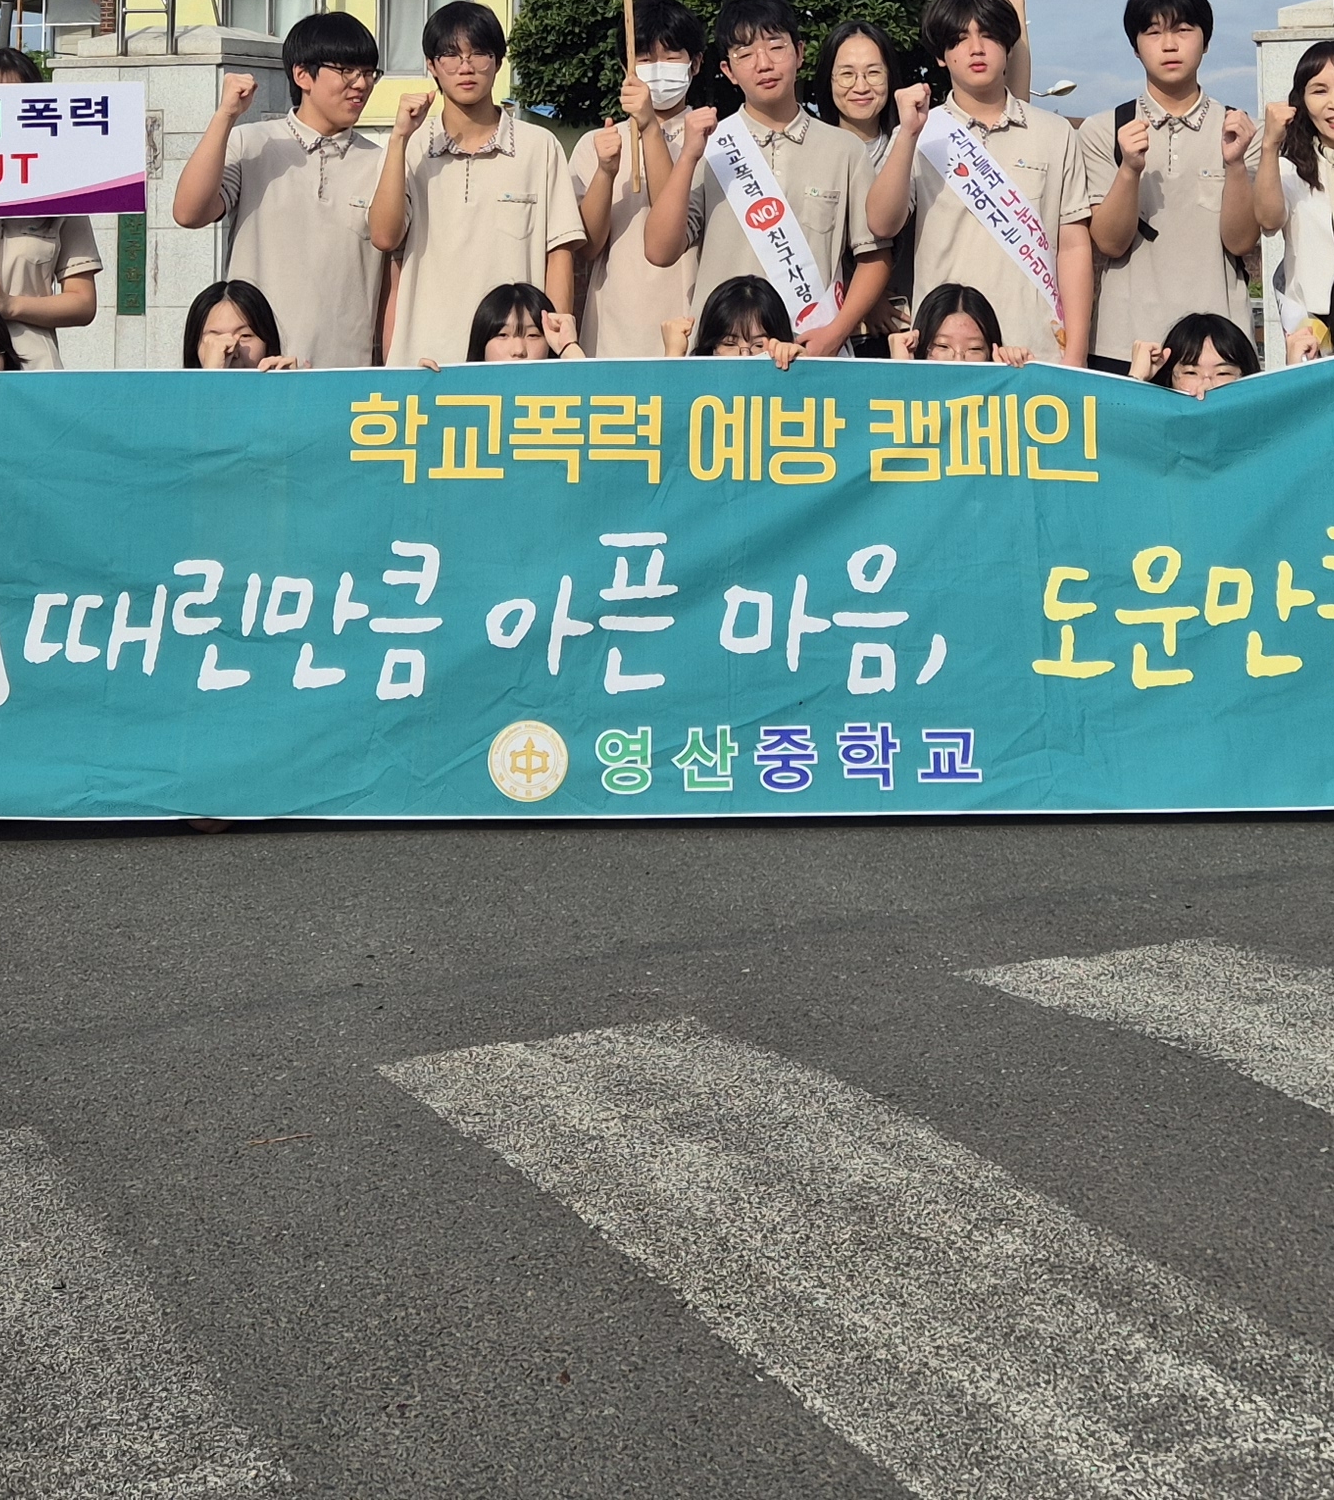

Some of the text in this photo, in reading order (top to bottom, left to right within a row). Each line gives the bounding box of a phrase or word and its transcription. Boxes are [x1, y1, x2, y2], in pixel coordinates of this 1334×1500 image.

[17, 96, 110, 137] 폭력
[716, 134, 764, 197] 학교폭력
[750, 200, 780, 226] NO!
[948, 128, 1005, 190] 친구들과
[962, 179, 1020, 245] 깊어지는
[350, 392, 1099, 484] 학교폭력 예방 캠페인
[23, 539, 442, 700] 때린만큼
[485, 532, 678, 694] 아픈
[720, 543, 947, 695] 마음,
[595, 722, 983, 795] 영산중학교
